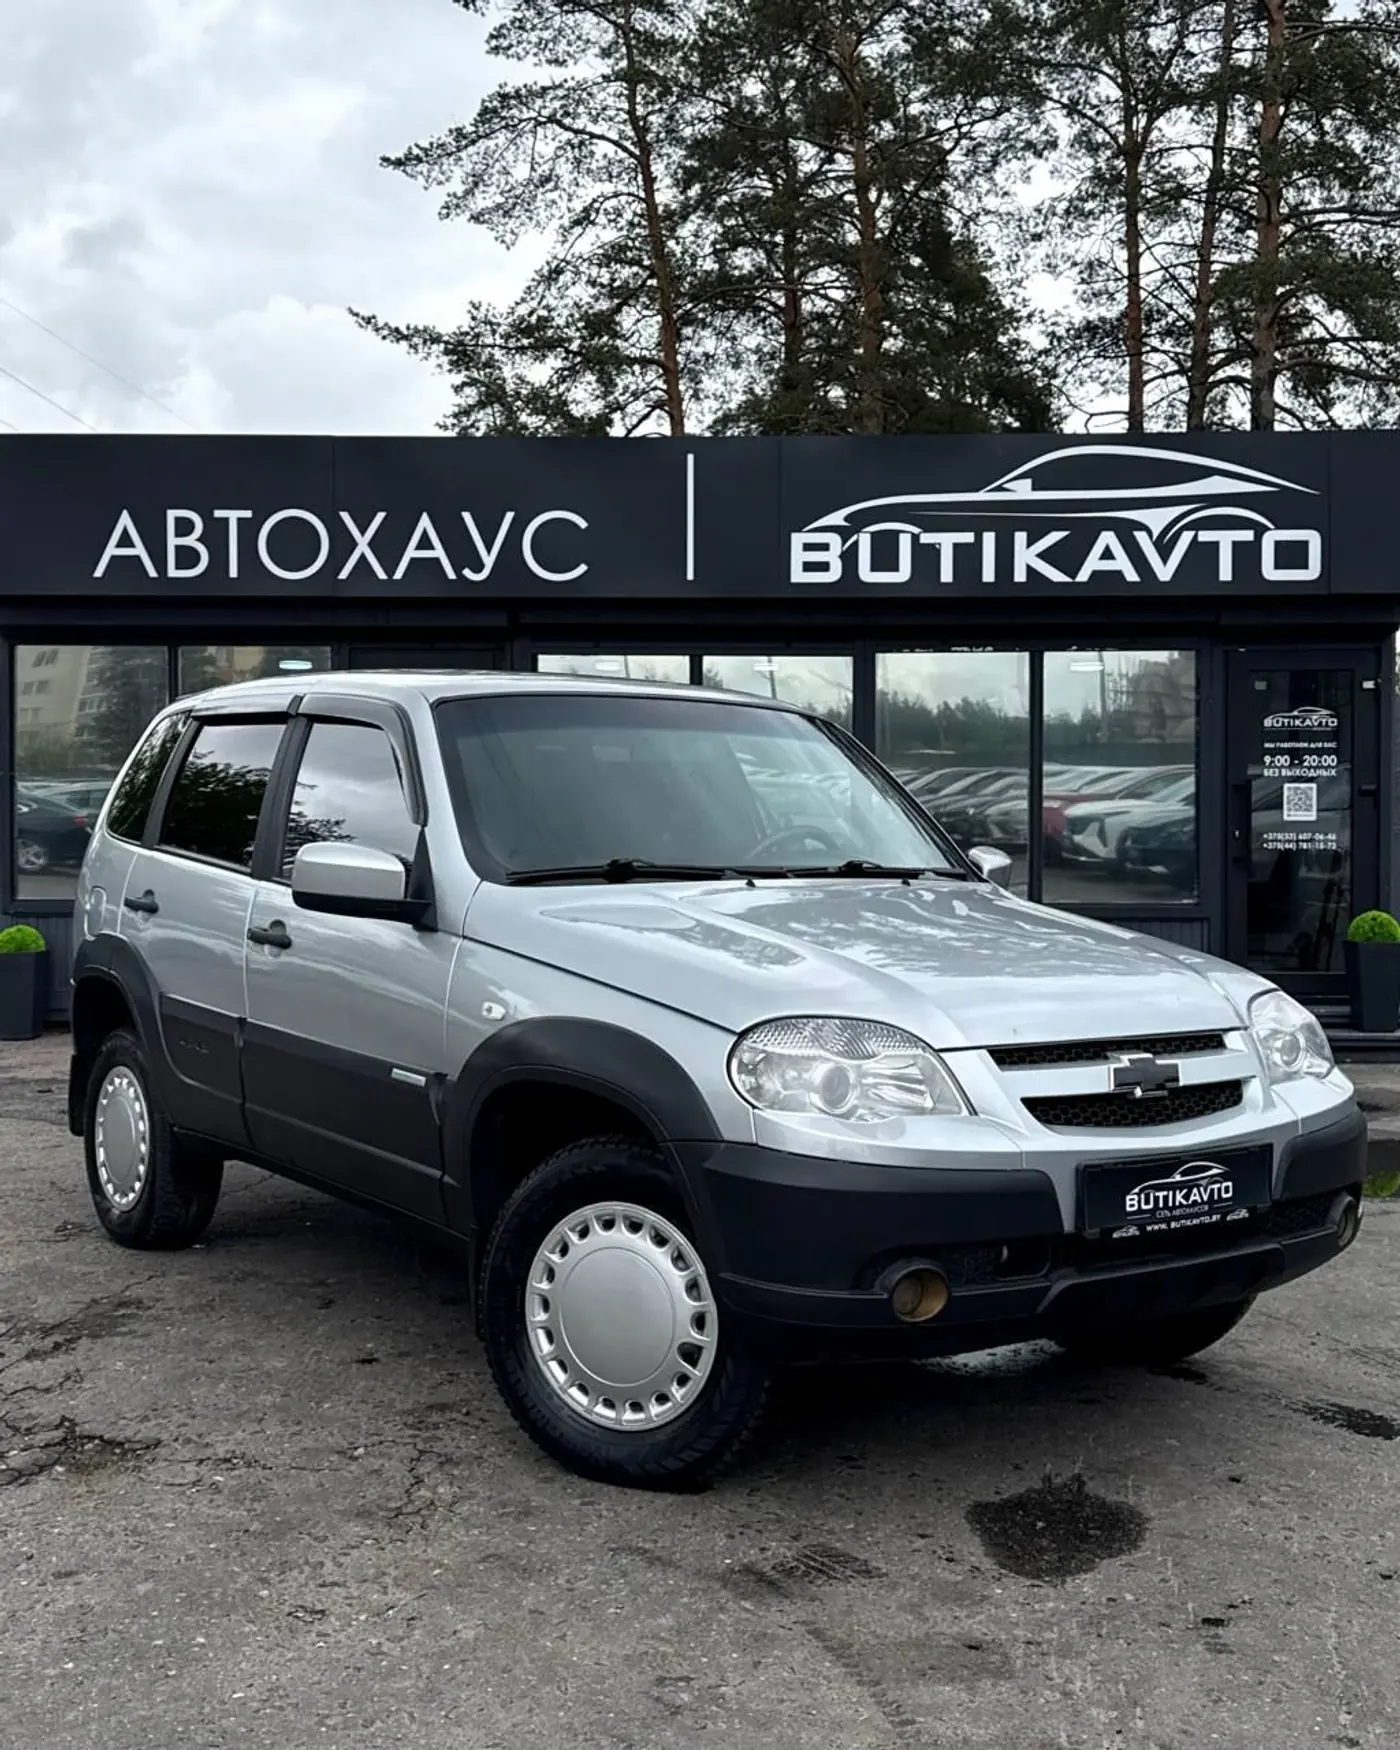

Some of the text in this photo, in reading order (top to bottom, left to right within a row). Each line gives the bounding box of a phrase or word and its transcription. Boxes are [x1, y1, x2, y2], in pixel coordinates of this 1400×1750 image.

[93, 508, 590, 583] АВТОХАУС
[790, 528, 1322, 584] BUTIKAVTO
[1263, 717, 1338, 727] BUTIKAVTO
[1263, 755, 1290, 767] 9:00
[1302, 755, 1338, 767] 20:00
[1263, 768, 1337, 778] БЕЗ ВЫХОДНЫХ
[1125, 1181, 1233, 1212] BUTIKAVTO
